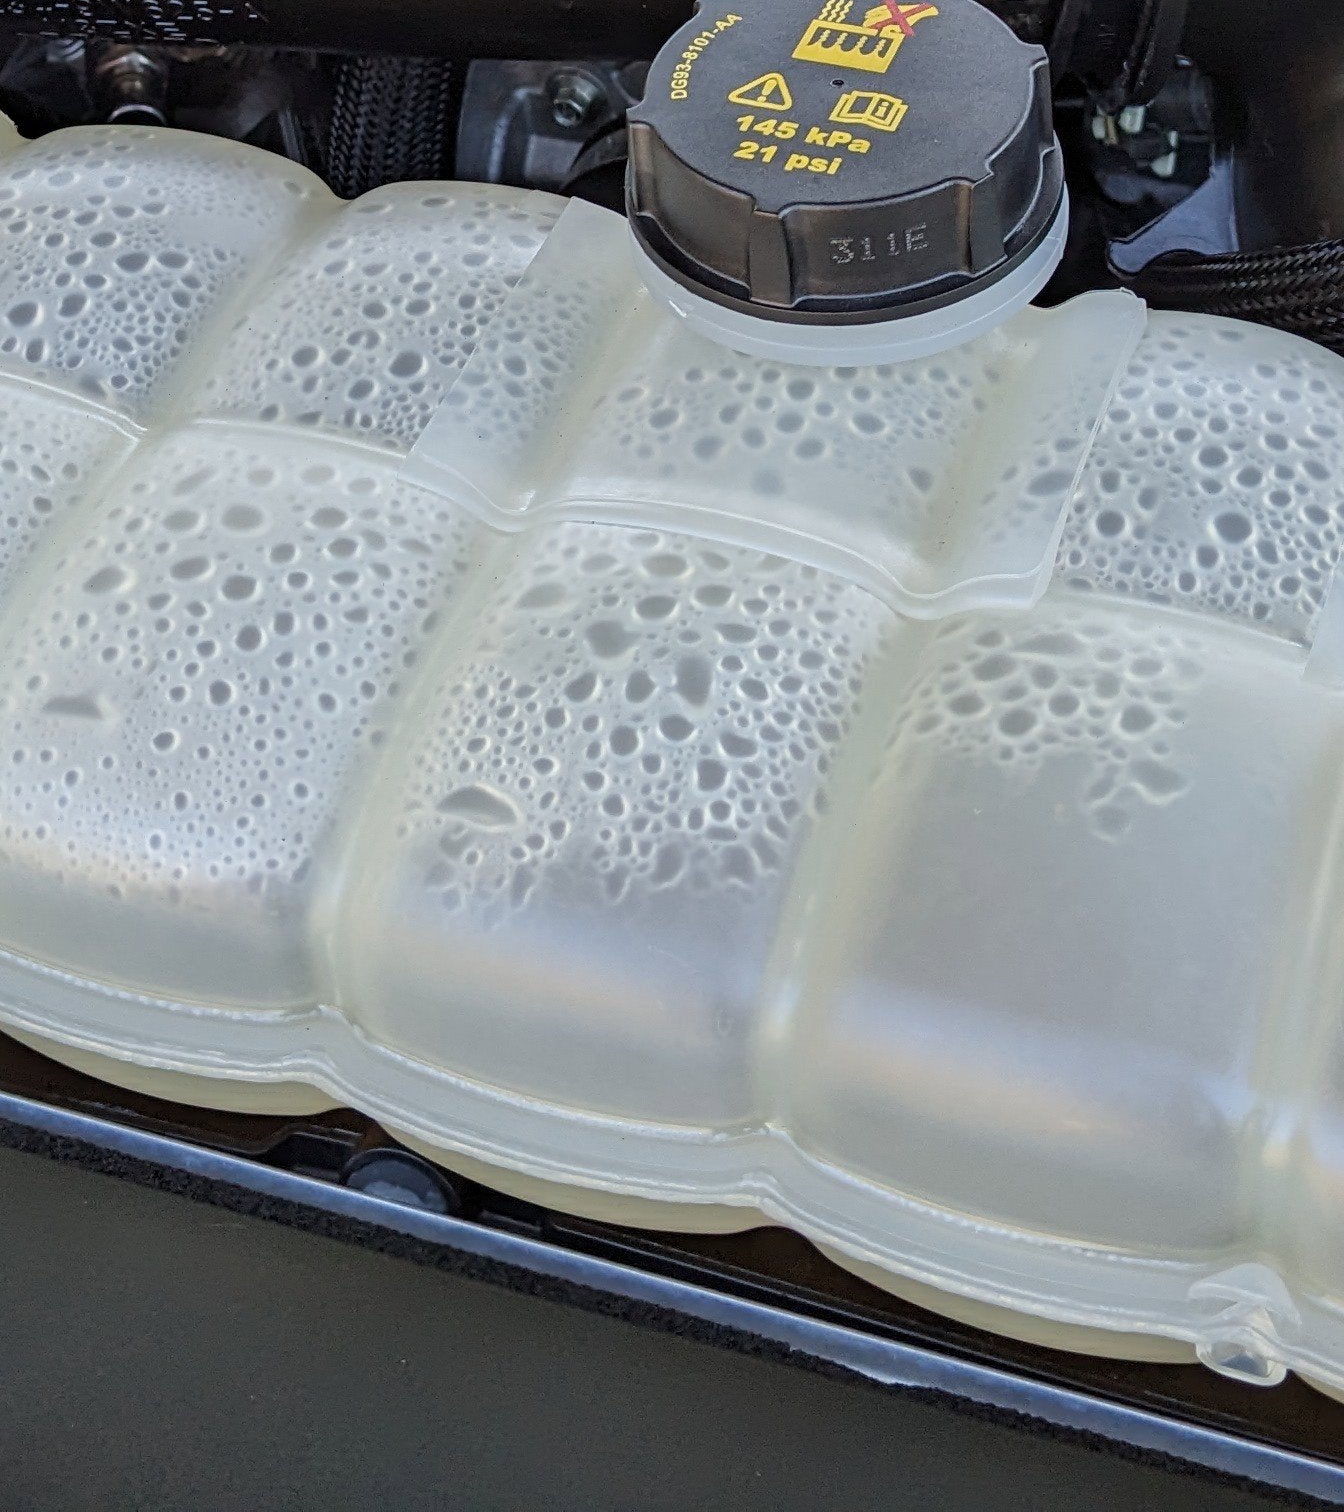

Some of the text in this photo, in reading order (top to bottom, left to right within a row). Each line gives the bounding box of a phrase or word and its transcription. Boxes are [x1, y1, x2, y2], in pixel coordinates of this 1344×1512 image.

[670, 12, 744, 101] DG93-8101-AA
[736, 114, 872, 155] 145 kPa
[732, 140, 844, 175] 21 psi
